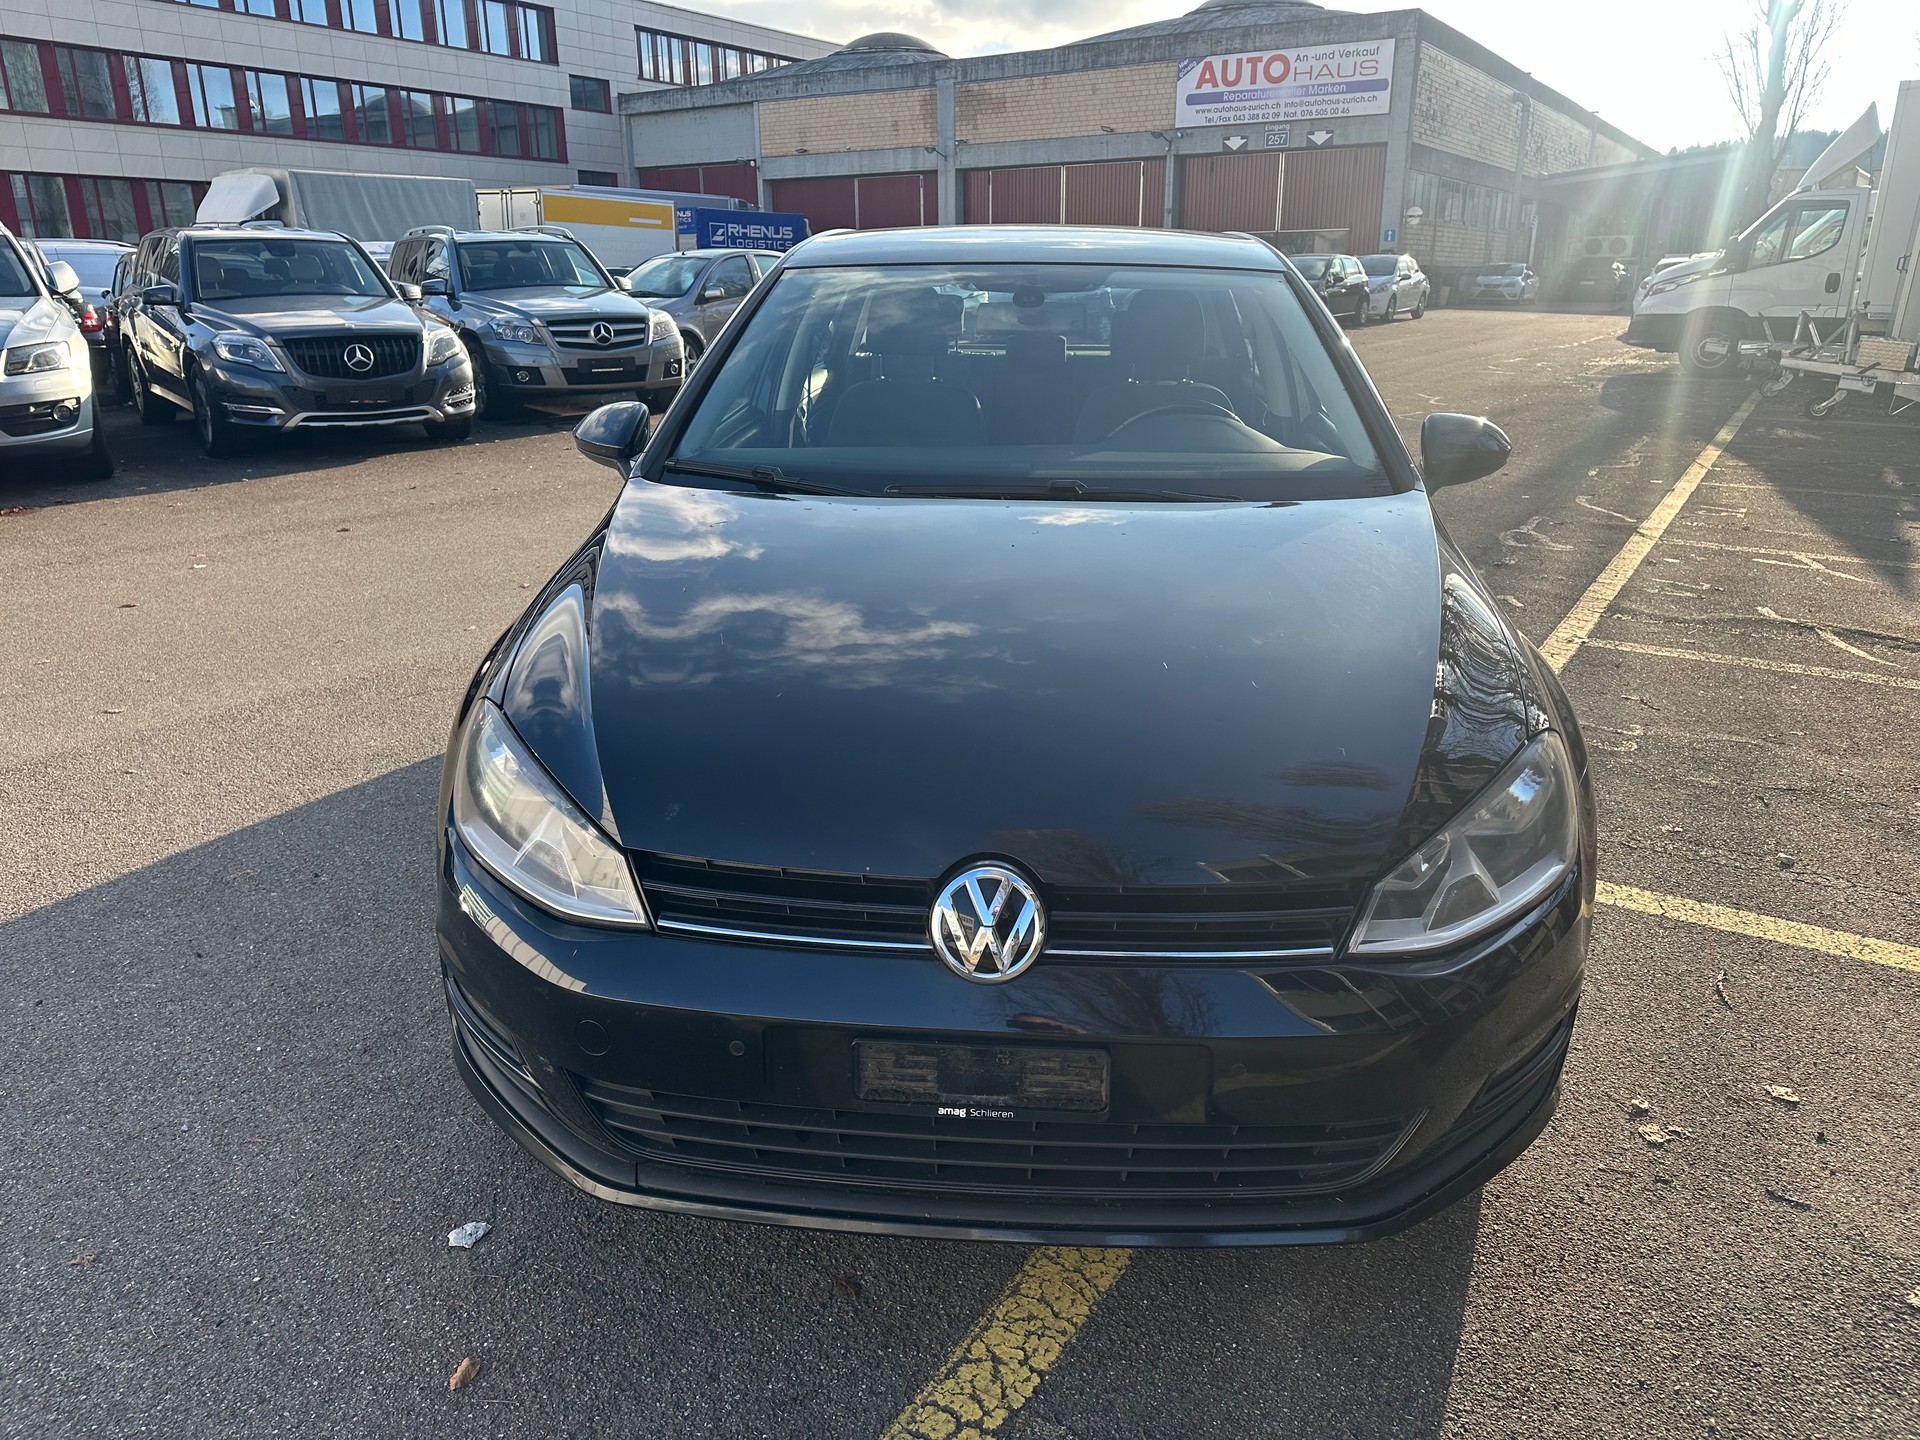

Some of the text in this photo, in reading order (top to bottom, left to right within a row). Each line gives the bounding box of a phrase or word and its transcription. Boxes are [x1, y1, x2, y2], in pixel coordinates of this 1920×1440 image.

[1294, 53, 1309, 63] An
[1338, 45, 1380, 59] Verkauf
[1195, 53, 1379, 90] AUTO HAUS
[1308, 83, 1347, 95] Marken
[1194, 95, 1378, 114] www.autohaus-zurich.ch info@autohaus-zurich.ch
[1233, 114, 1246, 122] 043
[1247, 113, 1261, 121] 388
[1261, 112, 1271, 120] 82
[1300, 109, 1313, 117] 076
[1314, 108, 1328, 116] 505
[1329, 107, 1340, 115] 00
[1340, 106, 1350, 115] 46
[1265, 123, 1291, 132] Eingang
[1268, 134, 1287, 145] 257
[727, 223, 793, 239] RHENUS
[728, 239, 793, 250] LOGISTICS
[937, 1106, 1014, 1119] amag Schlieren
